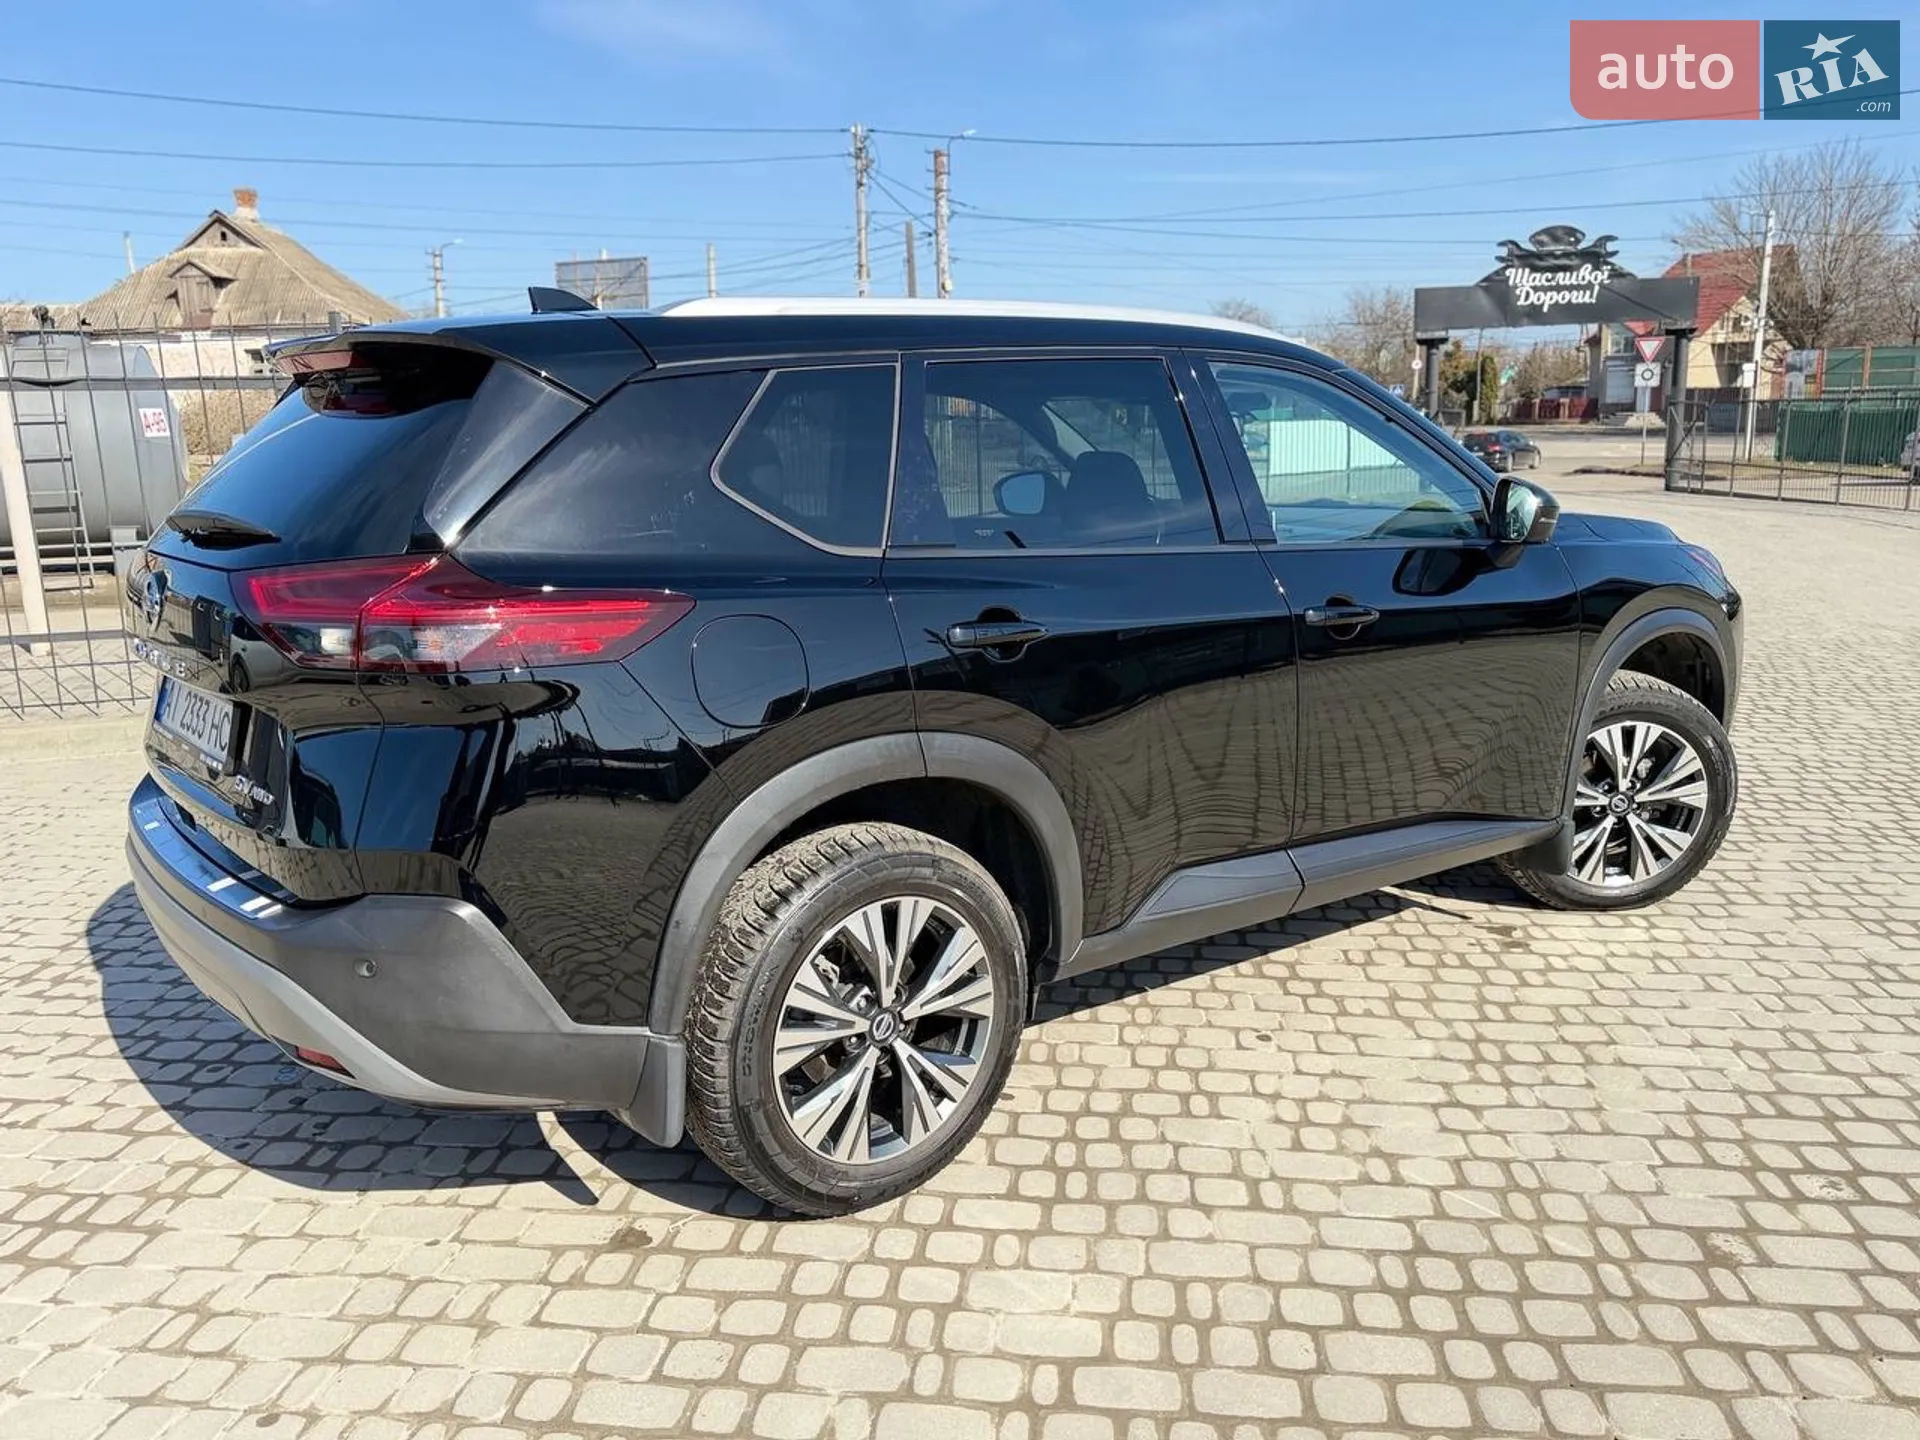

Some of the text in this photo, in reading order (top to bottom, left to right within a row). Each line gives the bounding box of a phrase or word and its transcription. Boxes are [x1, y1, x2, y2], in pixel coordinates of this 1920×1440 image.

[1505, 263, 1612, 287] Щасливої
[1515, 284, 1600, 313] Дороги!
[180, 689, 211, 741] 2333
[207, 702, 232, 753] HC
